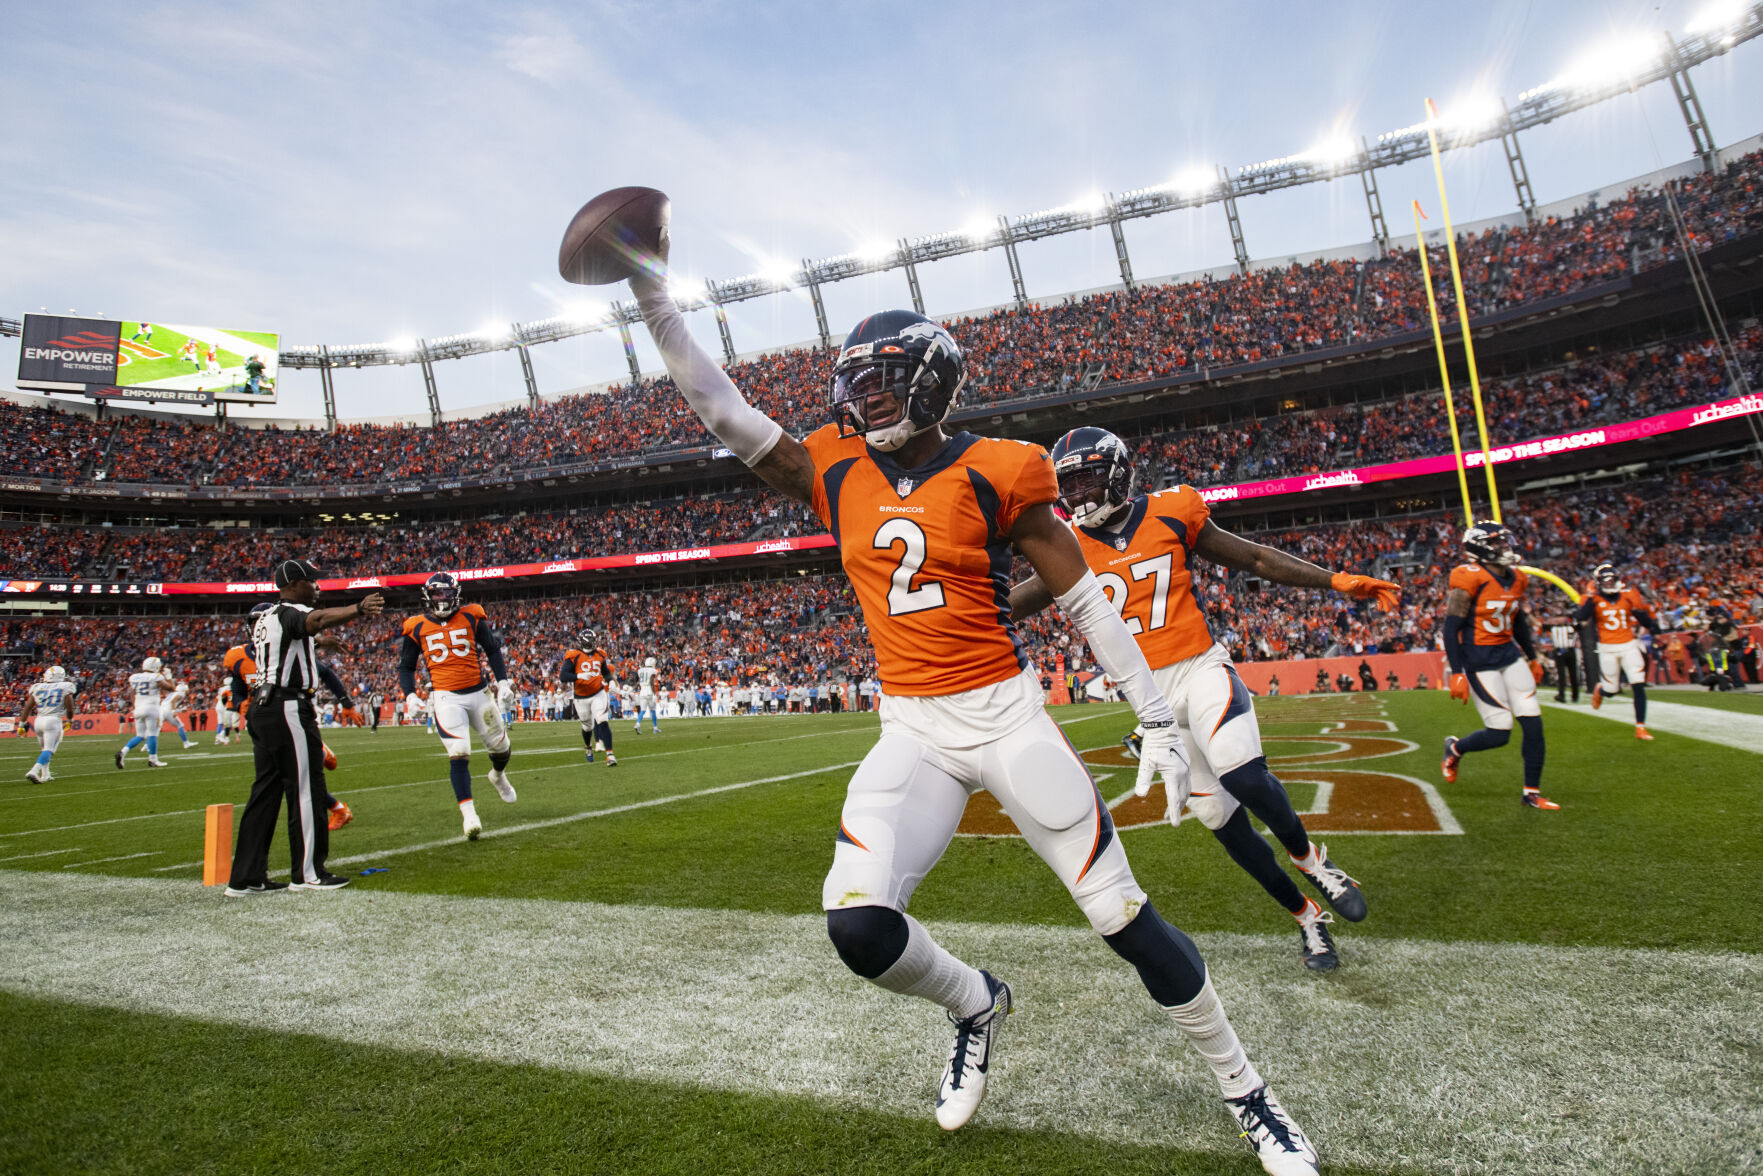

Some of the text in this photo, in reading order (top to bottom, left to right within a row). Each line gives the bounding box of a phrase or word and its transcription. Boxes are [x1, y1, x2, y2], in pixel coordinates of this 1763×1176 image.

[24, 348, 114, 364] EMPOWER
[63, 363, 114, 372] RETIREMENT
[122, 389, 207, 401] EMPOWER FIELD
[1690, 394, 1763, 425] uchealth
[1465, 430, 1606, 466] SPND THE SEASON
[1303, 471, 1362, 490] uchealth
[755, 539, 793, 553] uchealth
[635, 549, 711, 564] SPEND THE SEASON
[1108, 552, 1142, 566] BRONCOS
[459, 570, 474, 579] THE
[474, 568, 504, 578] SEASON
[543, 560, 576, 574] uchealth
[872, 517, 947, 617] 2
[226, 583, 254, 593] SPEND
[254, 583, 271, 593] THE
[348, 577, 381, 589] uchealth
[1094, 552, 1173, 636] 27
[1602, 609, 1627, 630] 31
[425, 628, 471, 663] 55
[35, 688, 63, 708] 30
